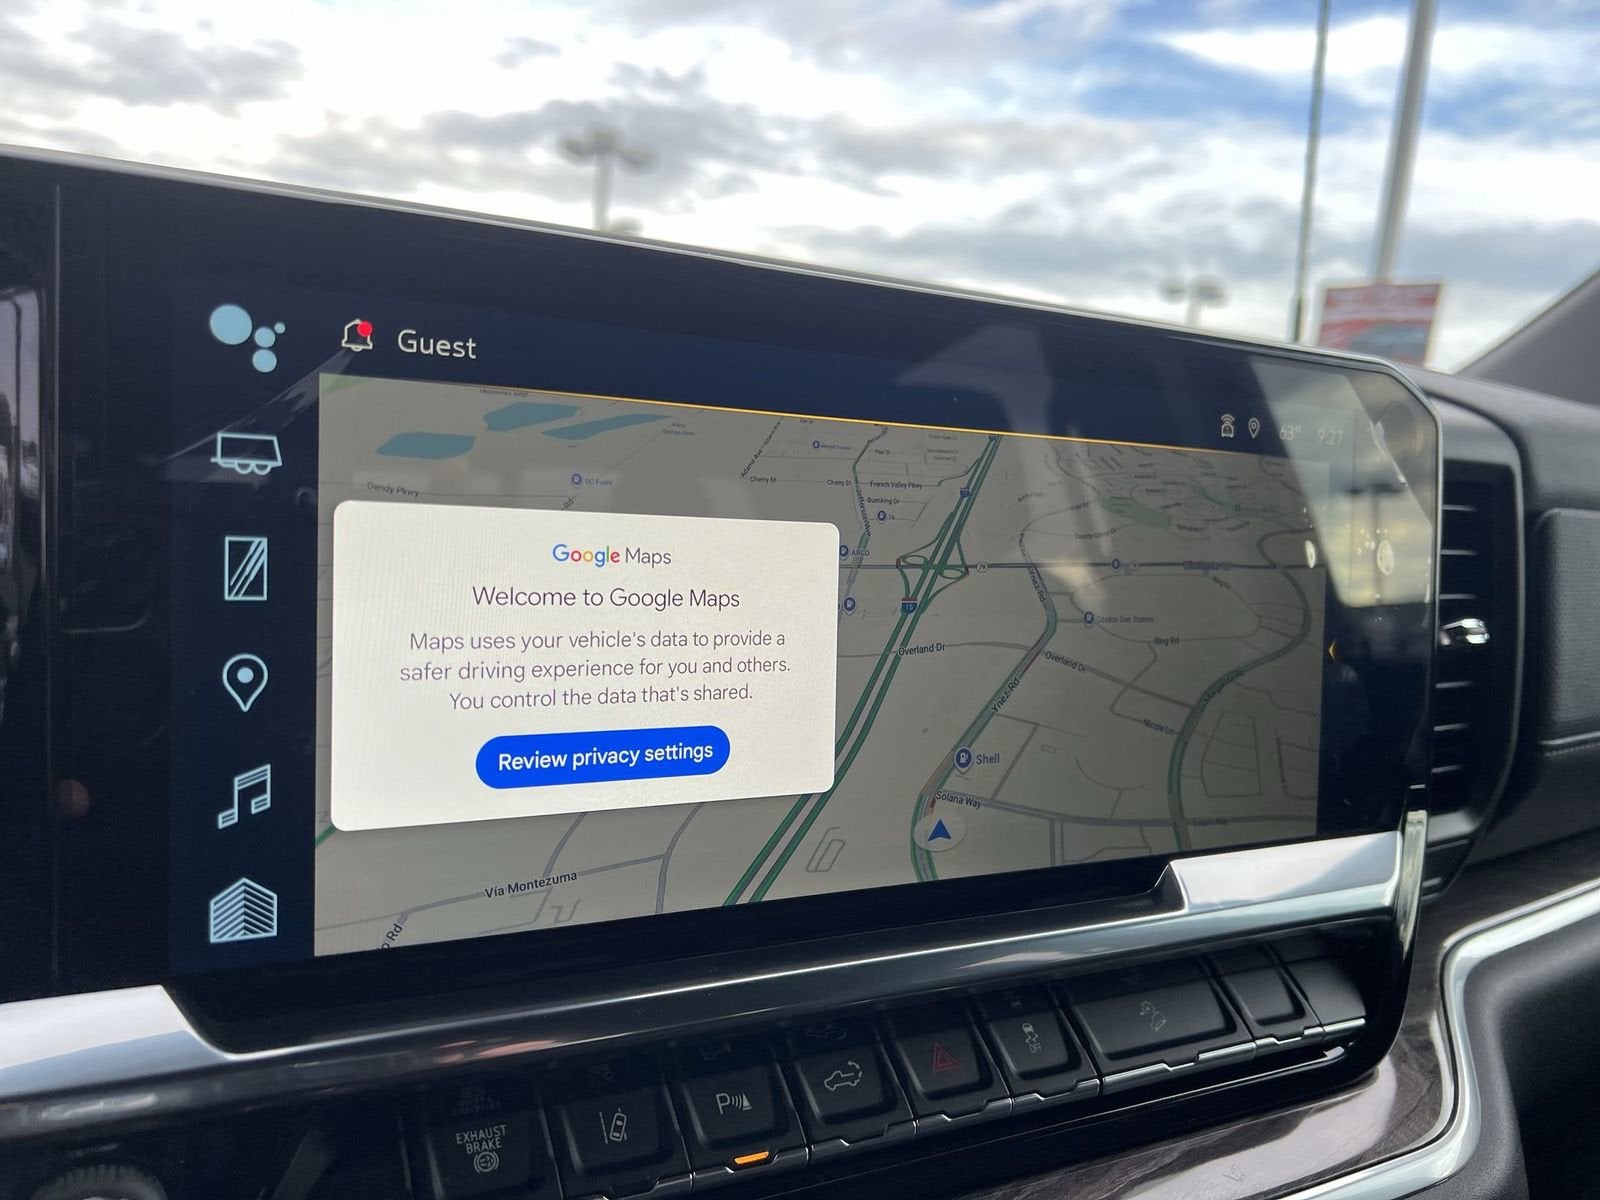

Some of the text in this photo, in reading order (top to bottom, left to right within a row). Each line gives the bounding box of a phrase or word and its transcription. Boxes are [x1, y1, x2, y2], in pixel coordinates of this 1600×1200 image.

[397, 329, 478, 360] Guest
[749, 475, 769, 485] Cherry
[396, 486, 419, 498] Pkwy
[552, 543, 672, 568] Google Maps
[851, 549, 870, 557] ARCO
[1028, 568, 1047, 603] Ynez Rd
[472, 585, 741, 612] Welcome to Google Maps
[409, 629, 786, 654] Maps uses your vehicle's data to provide a
[898, 642, 946, 657] Overland Dr
[1153, 636, 1180, 646] Ring Rd
[400, 656, 791, 682] safer driving experience for you and others.
[1045, 649, 1087, 673] Overland Dr
[449, 683, 754, 710] You control the data that's shared.
[991, 677, 1021, 714] Ynez Rd
[1142, 718, 1164, 733] Nicole
[498, 741, 714, 772] Review privacy settings
[975, 753, 1000, 765] Shell
[935, 790, 983, 810] Solana Way
[484, 870, 578, 899] Vía Montezuma
[385, 922, 403, 942] Rd
[455, 1123, 508, 1146] EXHAUST
[466, 1137, 503, 1154] BRAKE
